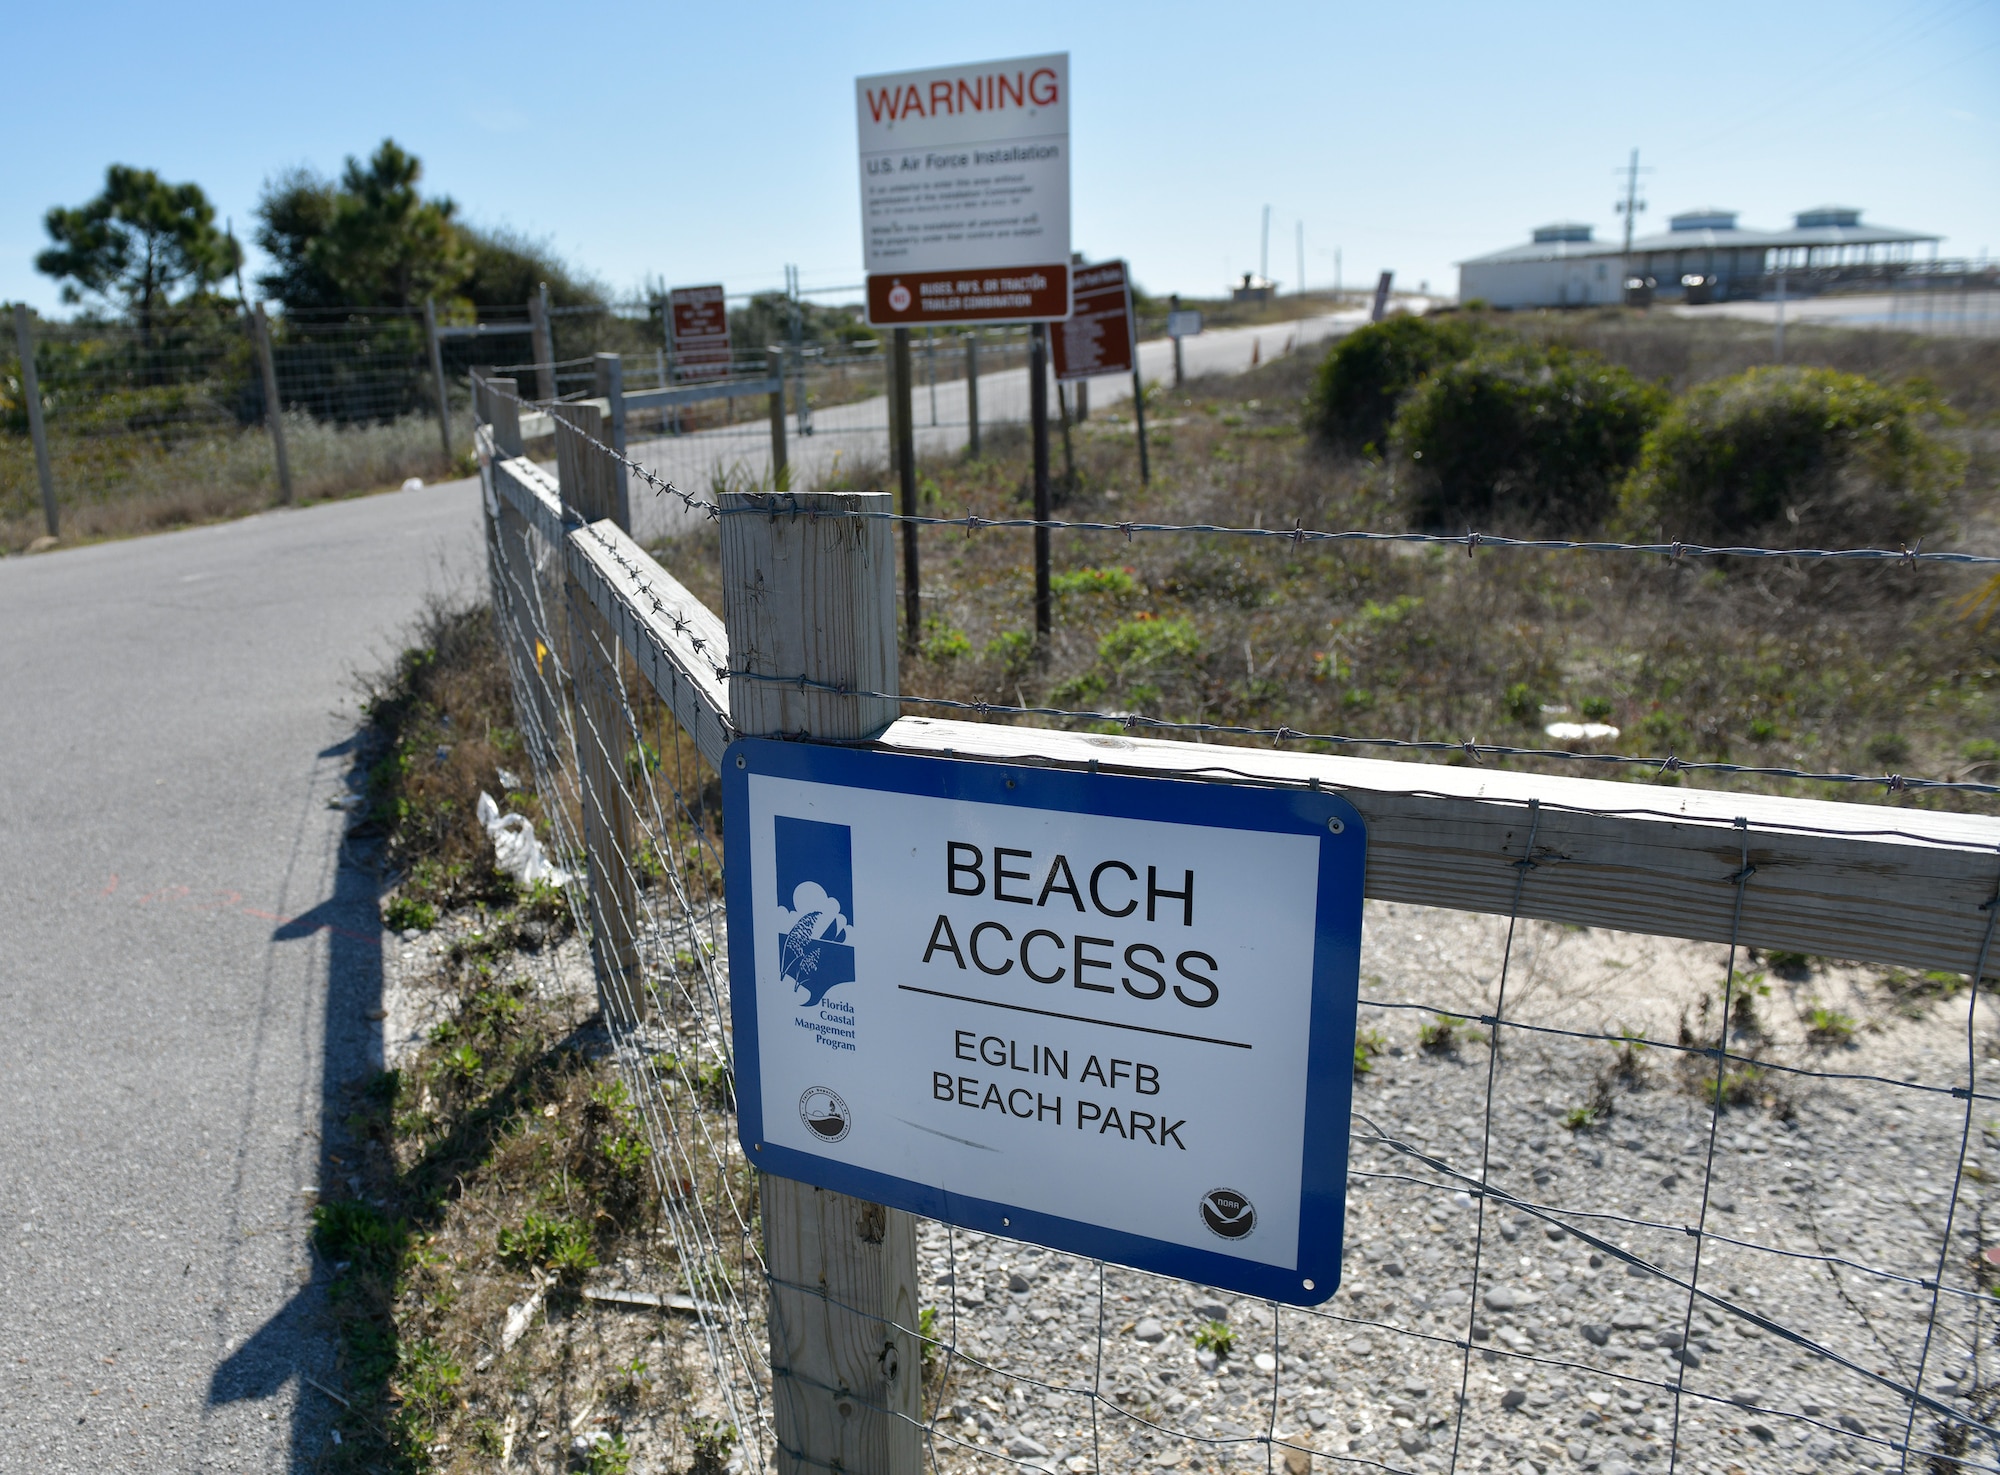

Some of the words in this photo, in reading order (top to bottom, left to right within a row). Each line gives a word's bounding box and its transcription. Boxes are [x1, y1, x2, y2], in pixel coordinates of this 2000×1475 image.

[866, 67, 1059, 124] WARNING
[866, 157, 896, 175] U.S.
[900, 155, 920, 172] Air
[926, 152, 969, 169] Force
[973, 144, 1059, 165] Installation
[983, 278, 999, 293] OR
[1000, 275, 1047, 292] TRACTOR
[921, 296, 961, 312] TRAILER
[963, 293, 1032, 310] COMBINATION
[947, 840, 1194, 927] BEACH
[922, 914, 1219, 1009] ACCESS
[821, 998, 855, 1014] Florida
[794, 1017, 856, 1039] Management
[819, 1010, 855, 1026] Coastal
[816, 1034, 856, 1052] Program
[954, 1029, 1068, 1080] EGLIN
[1079, 1055, 1161, 1096] AFB
[933, 1070, 1062, 1126] BEACH
[1077, 1100, 1187, 1151] PARK
[1217, 1198, 1240, 1210] NOAA
